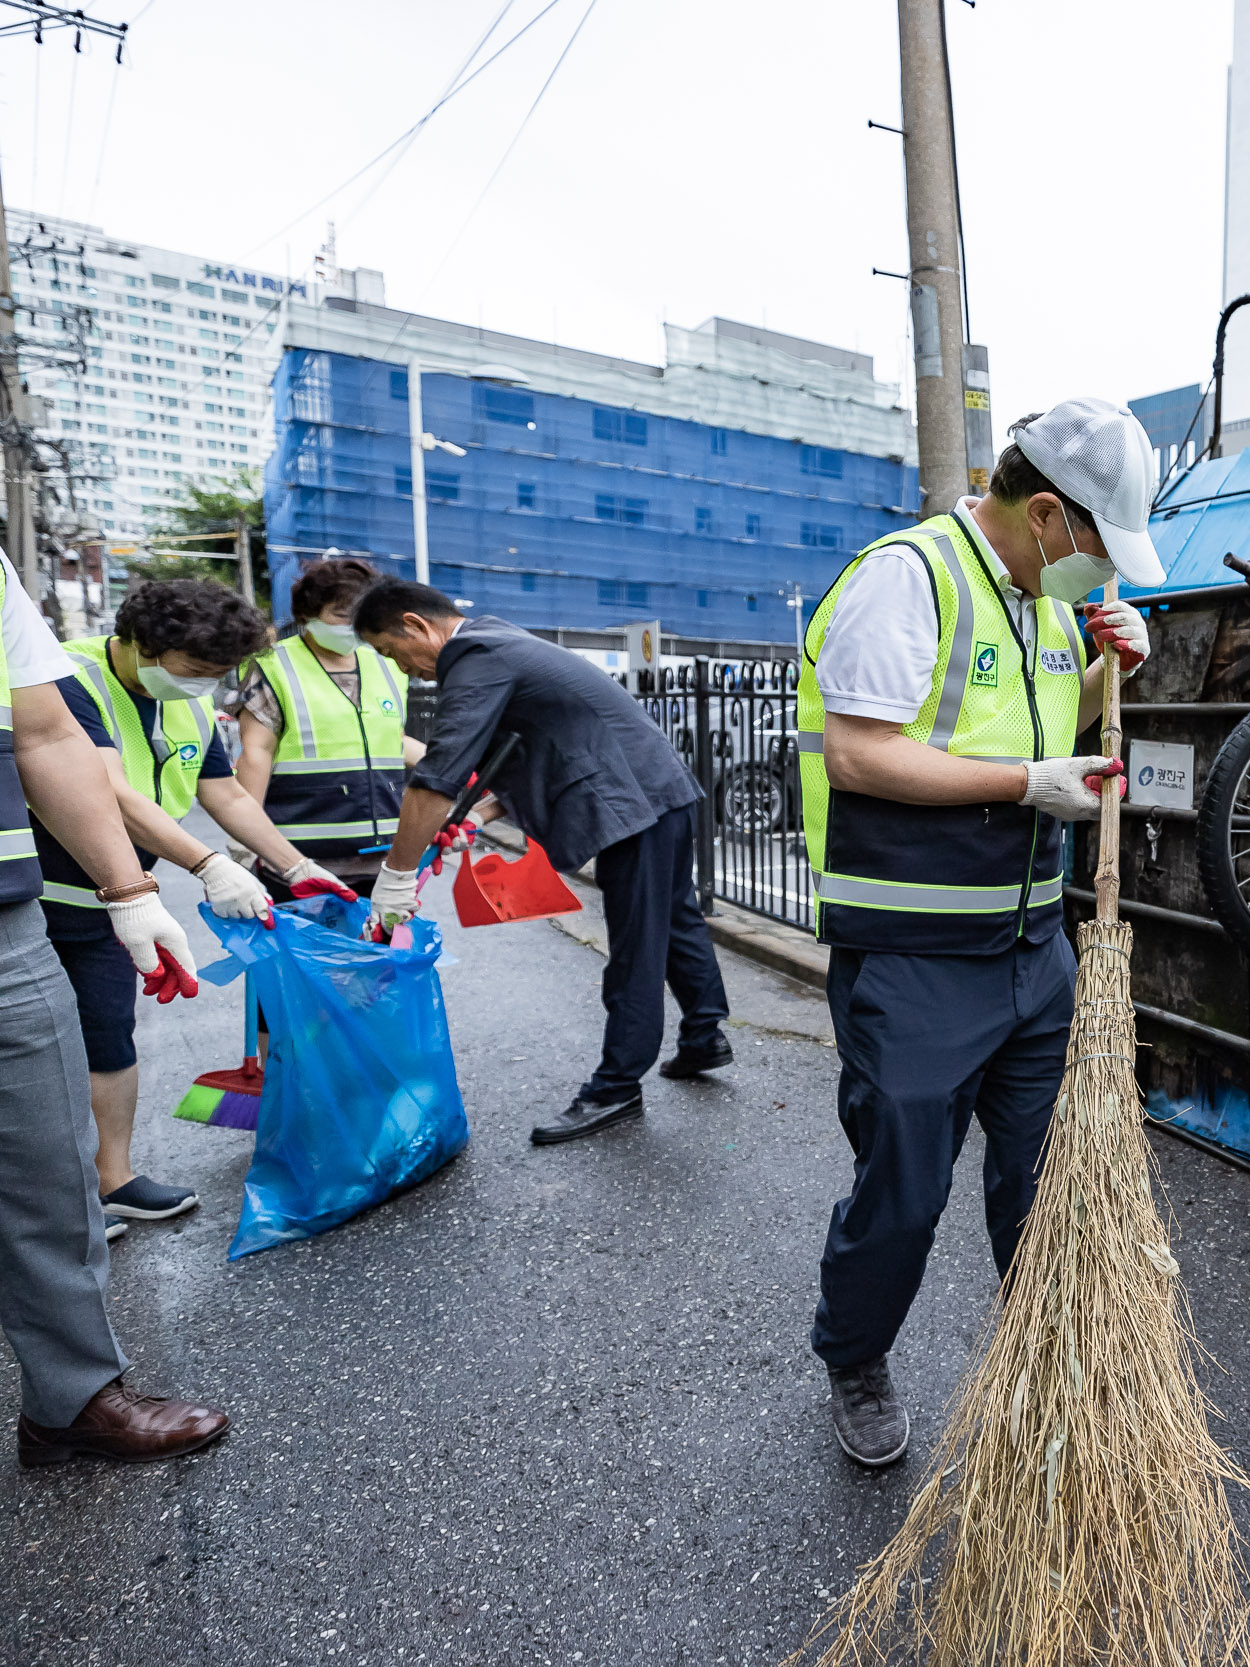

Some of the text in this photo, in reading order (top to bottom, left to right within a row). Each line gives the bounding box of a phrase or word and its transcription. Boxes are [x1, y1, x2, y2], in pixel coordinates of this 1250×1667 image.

[203, 264, 307, 298] HANRIM
[976, 672, 995, 682] 광진구
[1157, 768, 1186, 783] 광진구
